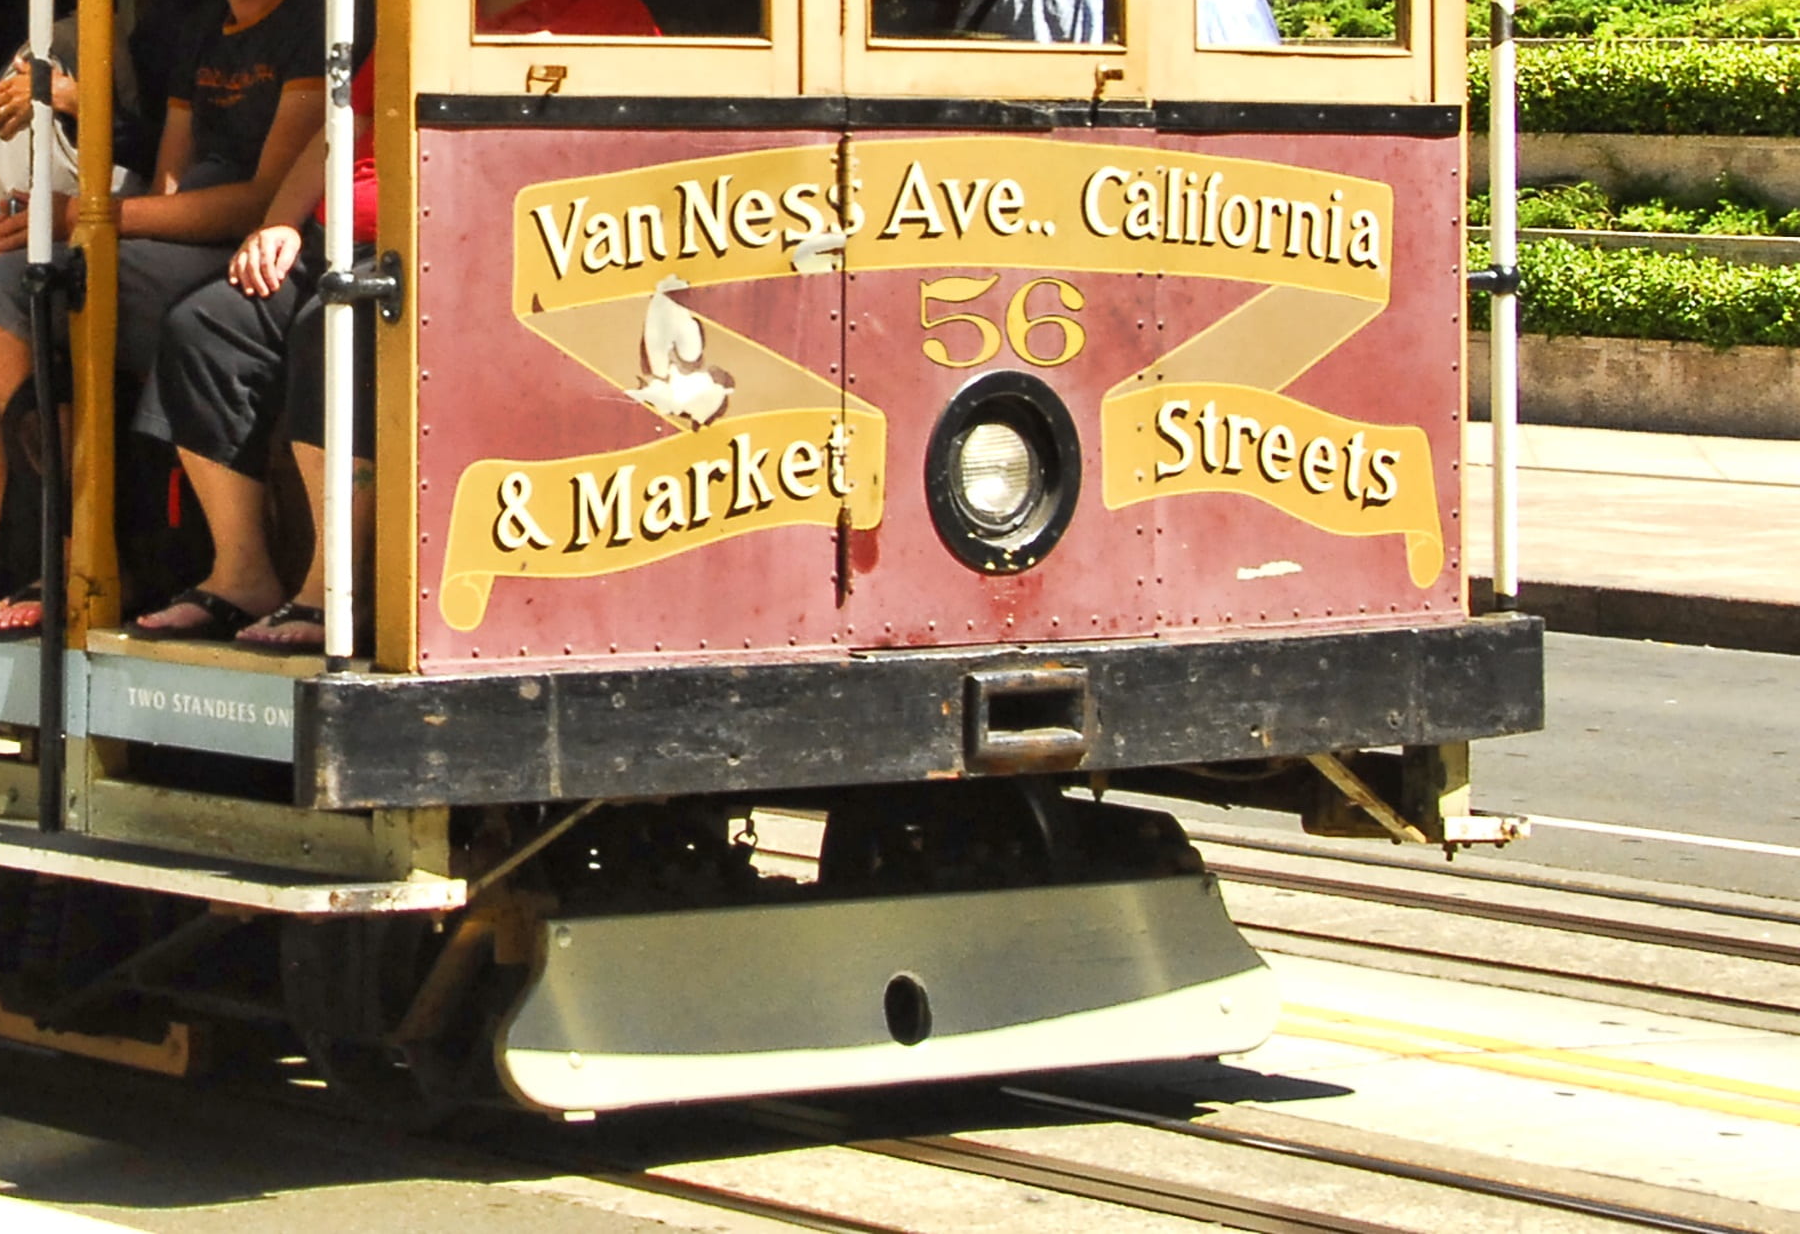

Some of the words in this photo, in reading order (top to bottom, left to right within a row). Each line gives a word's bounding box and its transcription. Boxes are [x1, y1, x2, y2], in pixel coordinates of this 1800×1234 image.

[530, 197, 668, 280] Van
[675, 174, 865, 260] Ness
[1080, 164, 1383, 268] California
[919, 276, 1086, 368] 56
[493, 469, 554, 553] &
[562, 421, 854, 553] Market
[1155, 399, 1402, 511] Streets
[129, 687, 166, 710] TWO
[172, 693, 257, 723] STANDEES
[263, 706, 294, 728] ON
